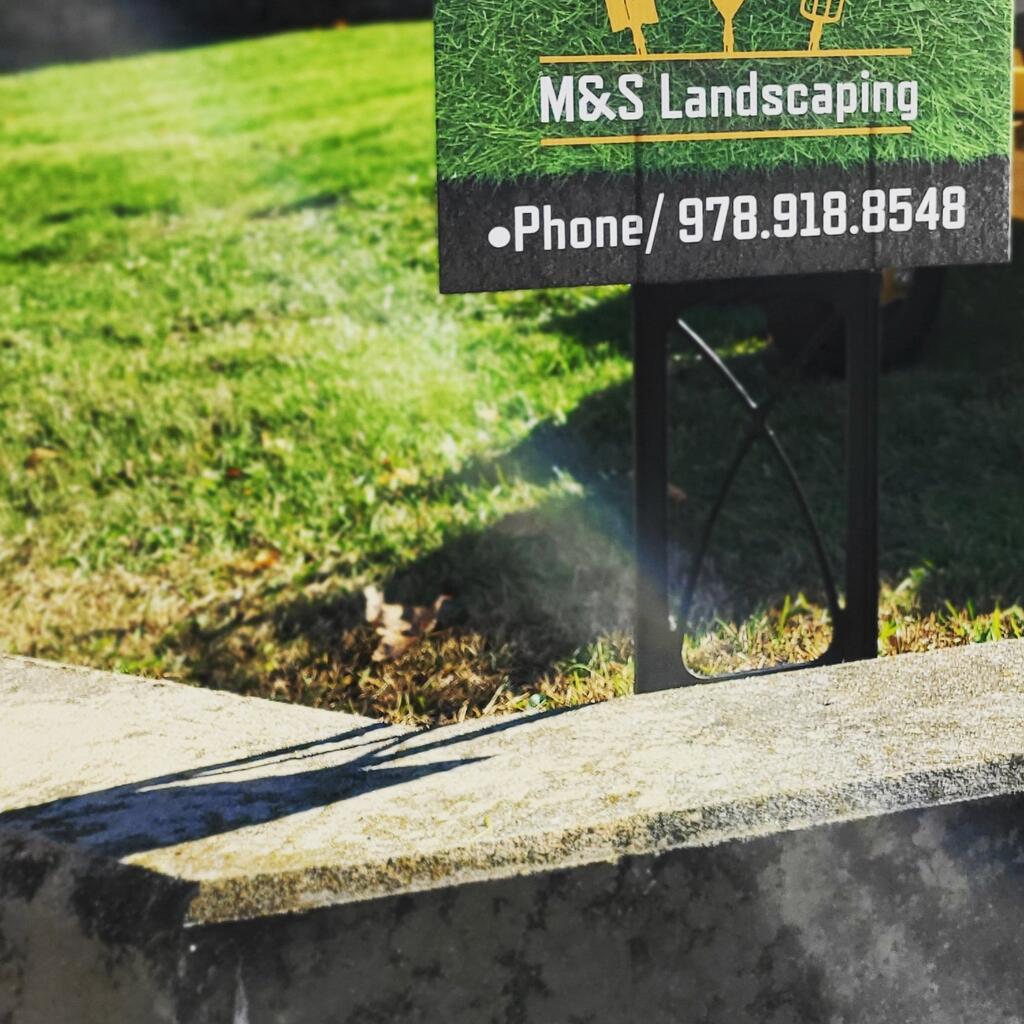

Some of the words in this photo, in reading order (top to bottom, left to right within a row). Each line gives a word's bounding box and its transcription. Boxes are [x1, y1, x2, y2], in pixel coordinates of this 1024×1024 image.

[539, 75, 643, 123] M&S
[661, 70, 918, 123] Landscaping
[678, 185, 966, 244] 978.918.8548
